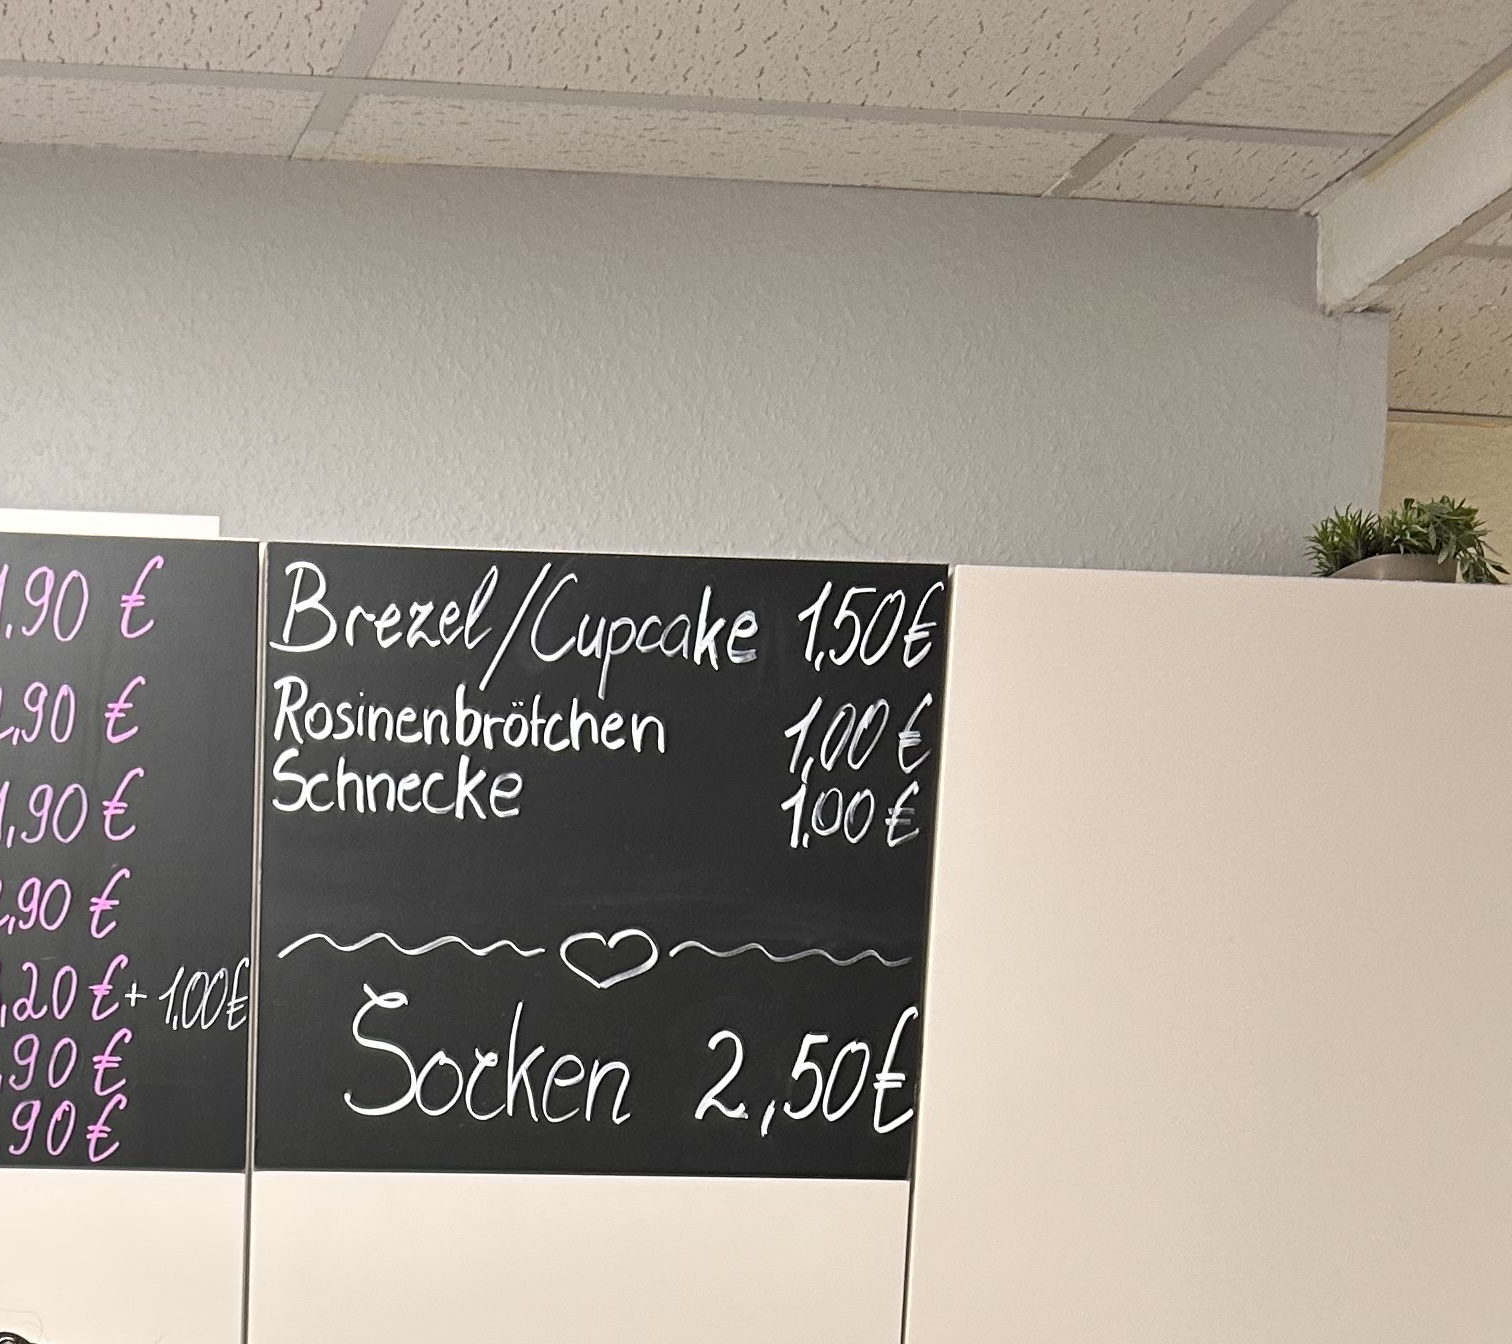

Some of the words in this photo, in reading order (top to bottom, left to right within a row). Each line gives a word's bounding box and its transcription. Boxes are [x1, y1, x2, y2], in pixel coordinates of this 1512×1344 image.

[273, 676, 666, 754] Rosinenbrötchen
[272, 749, 523, 820] Schnecke
[344, 984, 631, 1124] Socken
